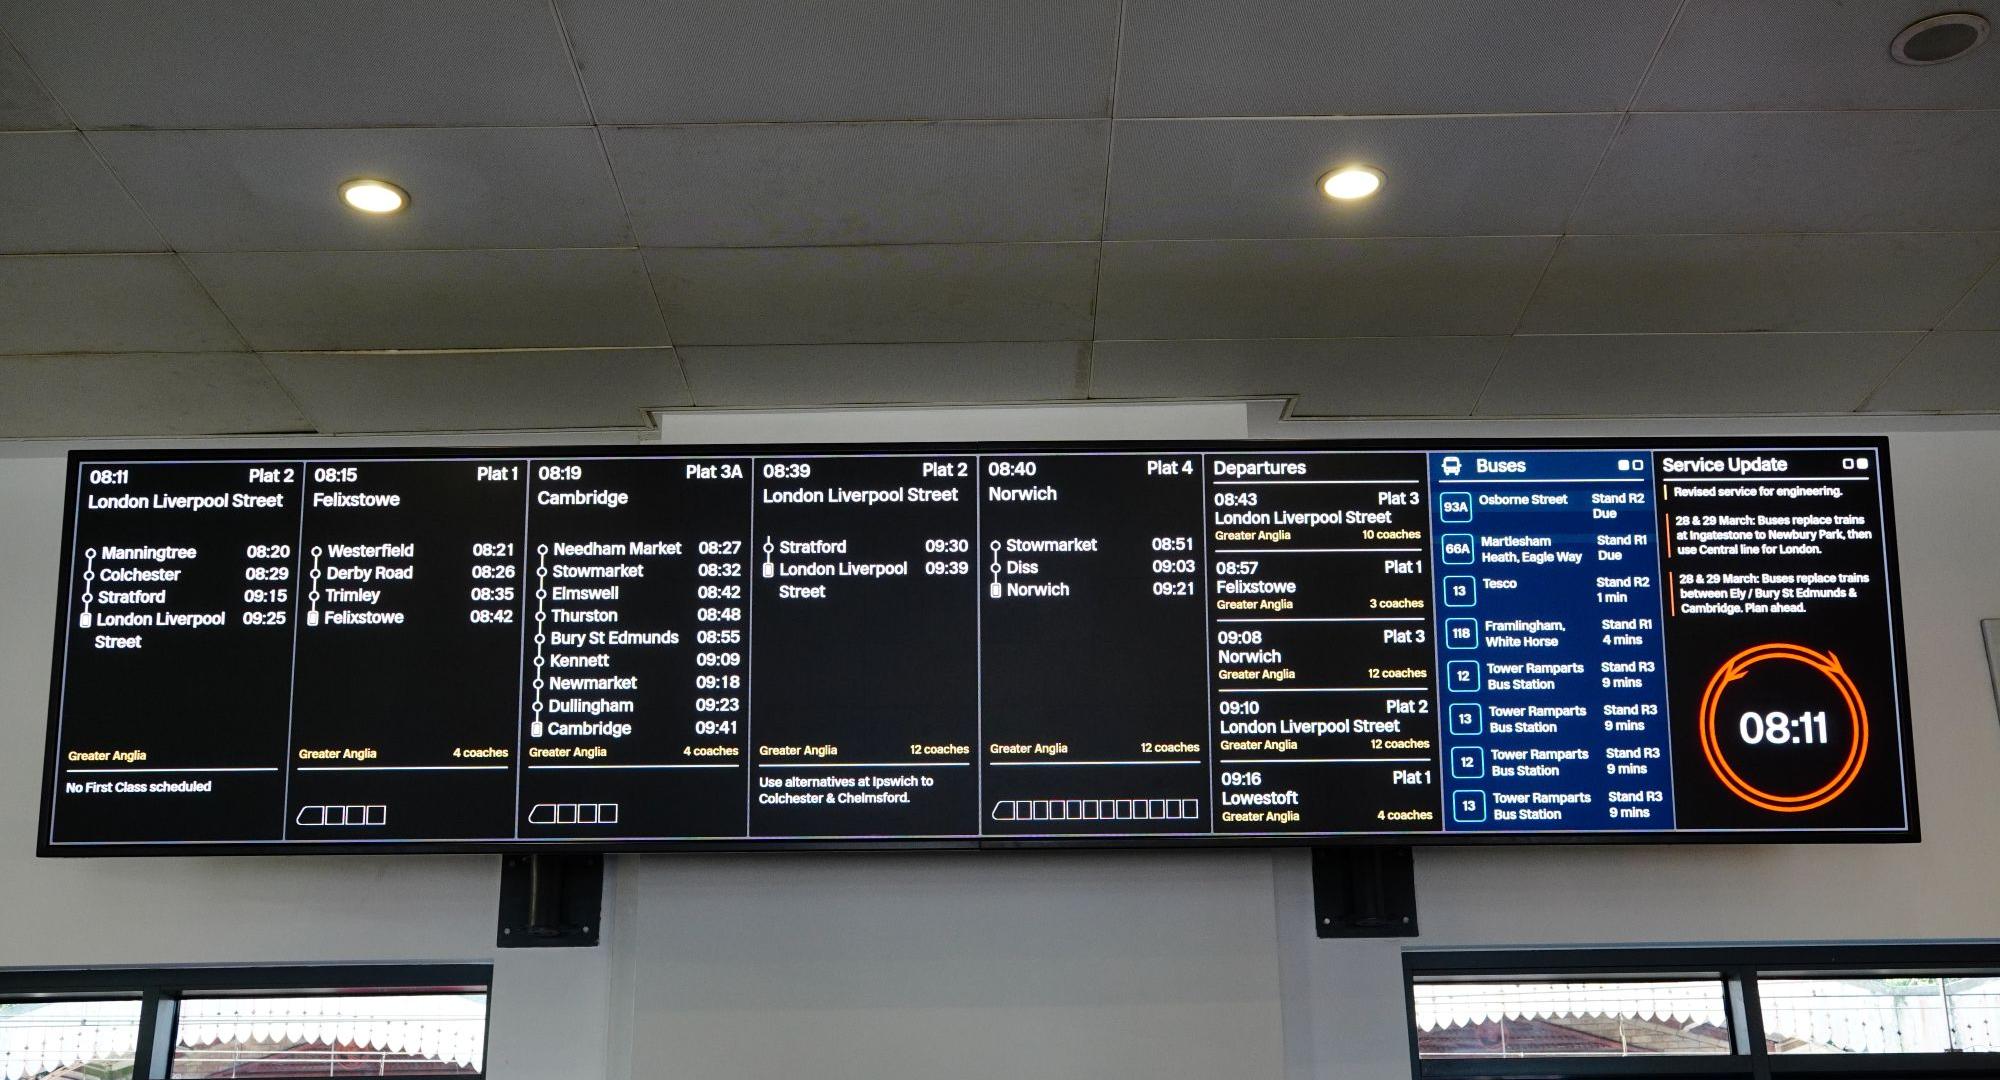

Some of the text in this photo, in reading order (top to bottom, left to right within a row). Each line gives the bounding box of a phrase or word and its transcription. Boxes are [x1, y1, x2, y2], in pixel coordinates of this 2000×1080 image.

[538, 465, 582, 480] 08:19
[686, 464, 743, 479] Plat 3A
[763, 463, 811, 478] 08:39
[923, 462, 968, 477] Plat 2
[988, 461, 1037, 476] 08:40
[1147, 460, 1194, 475] Plat 4
[1214, 460, 1307, 478] Departures
[1477, 458, 1527, 473] Buses
[1663, 457, 1788, 475] Service Update
[90, 469, 128, 484] 08:11
[249, 468, 294, 483] Plat 2
[314, 467, 357, 482] 08:15
[477, 466, 518, 481] Plat 1
[537, 489, 629, 508] Cambridge
[989, 485, 1057, 501] Norwich
[1214, 492, 1257, 506] 08:43
[1378, 491, 1420, 505] Plat 3
[1592, 492, 1645, 504] Stand R2
[1674, 485, 1843, 499] Revised service for engineering.
[88, 493, 284, 511] London Liverpool Street
[313, 492, 400, 507] Felixstowe
[1444, 501, 1468, 512] 93A
[1479, 494, 1568, 505] Osborne Street
[1215, 510, 1392, 527] London Liverpool Street
[1592, 508, 1617, 519] Due
[1675, 514, 1865, 527] 28 & 29 March: Buses replace trains
[1215, 529, 1291, 542] Greater Anglia
[1362, 529, 1421, 539] 10 coaches
[1481, 535, 1552, 547] Martlesham
[1597, 534, 1647, 545] Stand R1
[1676, 528, 1872, 543] at Ingatestone to Newbury Park, then
[328, 543, 414, 558] Westerfield
[473, 543, 513, 557] 08:21
[554, 541, 682, 556] Needham Market
[698, 541, 742, 555] 08:27
[780, 539, 847, 554] Stratford
[925, 539, 969, 553] 09:30
[1006, 537, 1098, 552] Stowmarket
[1152, 537, 1193, 551] 08:51
[1445, 543, 1471, 554] 66A
[1677, 543, 1822, 555] use Central line for London.
[102, 545, 197, 562] Manningtree
[247, 545, 290, 558] 08:20
[1482, 551, 1583, 565] Heath, Eagle Way
[1598, 550, 1622, 561] Due
[553, 563, 644, 578] Stowmarket
[698, 563, 741, 577] 08:32
[780, 561, 907, 578] London Liverpool
[925, 561, 969, 575] 09:39
[1007, 560, 1039, 574] Diss
[1152, 559, 1195, 573] 09:03
[100, 567, 182, 582] Colchester
[245, 567, 289, 581] 08:29
[327, 565, 413, 582] Derby Road
[552, 585, 619, 600] Elmswell
[698, 585, 741, 599] 08:42
[779, 585, 826, 598] Street
[1007, 582, 1070, 596] Norwich
[1153, 581, 1194, 595] 09:21
[551, 608, 618, 623] Thurston
[697, 607, 741, 621] 08:48
[1452, 628, 1471, 638] 118
[1485, 619, 1566, 634] Framlingham,
[551, 630, 679, 648] Bury St Edmunds
[697, 630, 740, 644] 08:55
[1485, 636, 1559, 647] White Horse
[1602, 634, 1643, 645] 4 mins
[1486, 662, 1584, 676] Tower Ramparts
[1601, 661, 1655, 673] Stand R3
[1457, 670, 1470, 681] 12
[1602, 676, 1643, 688] 9 mins
[1488, 678, 1555, 690] Bus Station
[549, 698, 634, 715] Dullingham
[696, 697, 739, 712] 09:23
[1739, 711, 1827, 744] 08:11
[299, 748, 377, 761] Greater Anglia
[453, 747, 509, 758] 4 coaches
[910, 743, 970, 755] 12 coaches
[68, 750, 147, 763] Greater Anglia
[759, 775, 934, 789] Use alternatives at Ipswich to
[1221, 772, 1262, 786] 09:16
[1393, 770, 1431, 784] Plat 1
[66, 780, 212, 793] No First Class scheduled
[759, 791, 910, 804] Colchester & Chelmsford.
[1222, 790, 1299, 805] Lowestoft
[1222, 810, 1300, 824] Greater Anglia
[1377, 809, 1433, 820] 4 coaches
